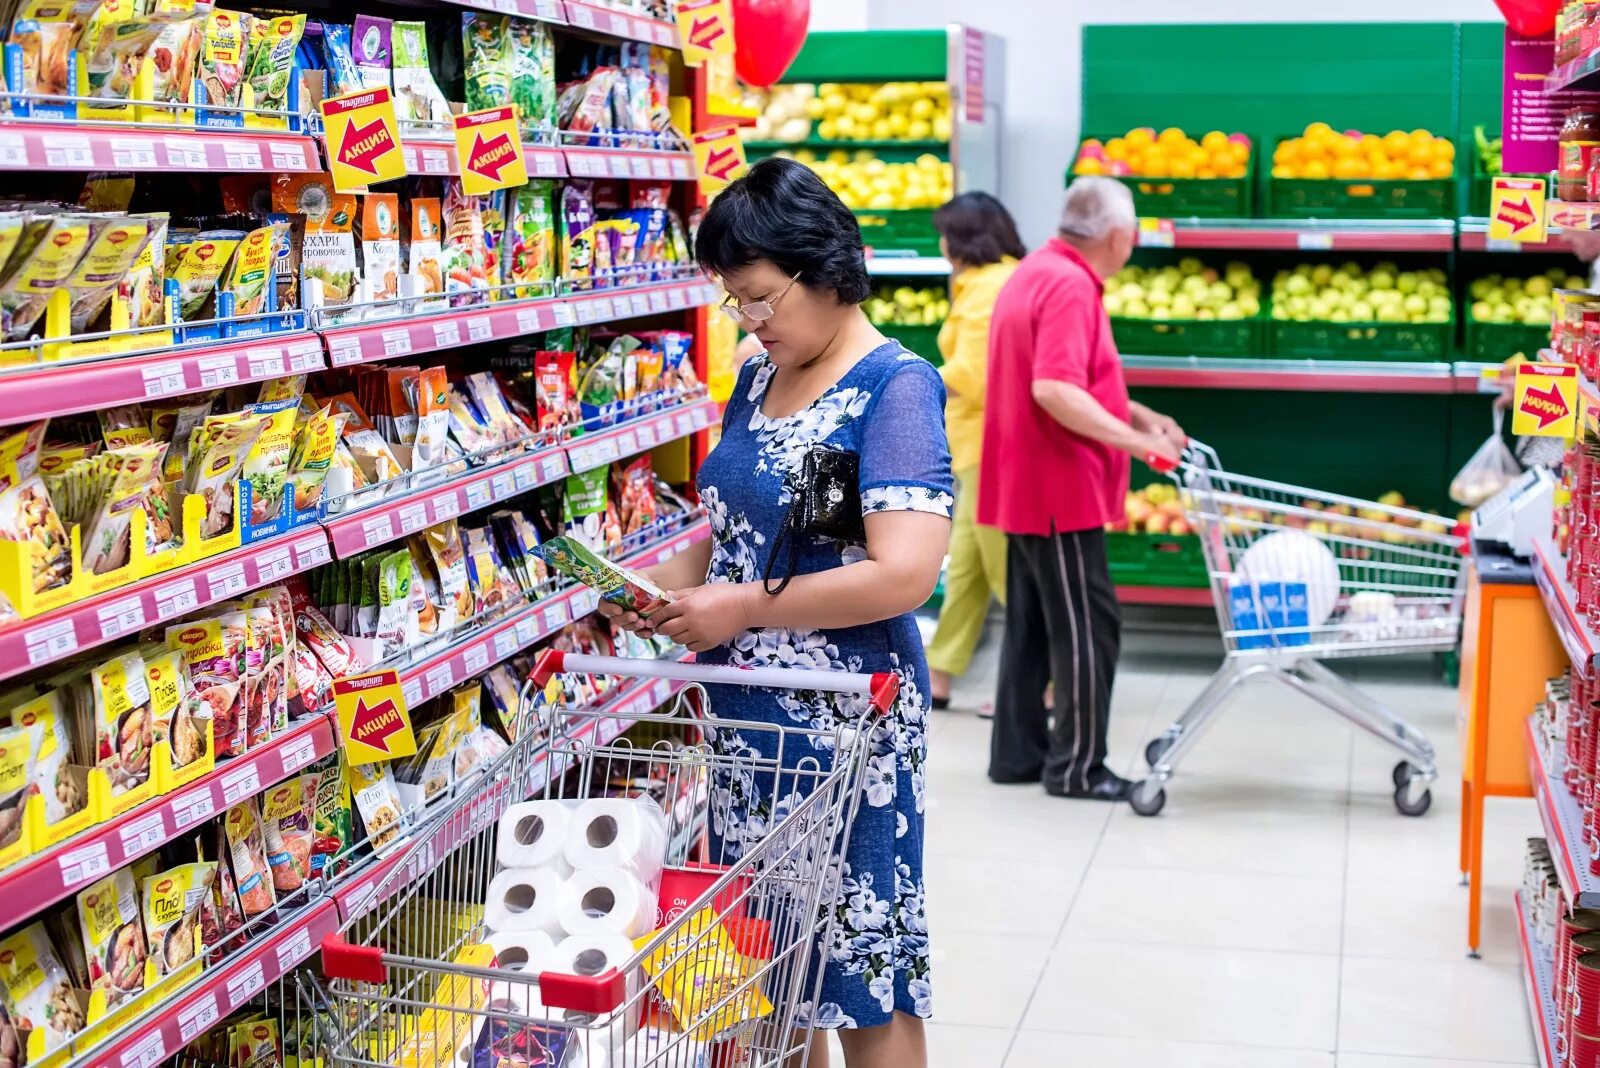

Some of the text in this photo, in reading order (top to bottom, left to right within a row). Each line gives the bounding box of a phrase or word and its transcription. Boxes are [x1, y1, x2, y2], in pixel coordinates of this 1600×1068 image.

[341, 93, 375, 109] magnum
[345, 129, 390, 162] АКЦИЯ
[473, 142, 514, 172] АКЦИЯ
[302, 235, 339, 248] УХАРИ
[172, 288, 181, 334] НОВИНА
[251, 527, 278, 541] НОВИНКА
[351, 676, 383, 690] magnum
[358, 708, 400, 739] АКЦИЯ
